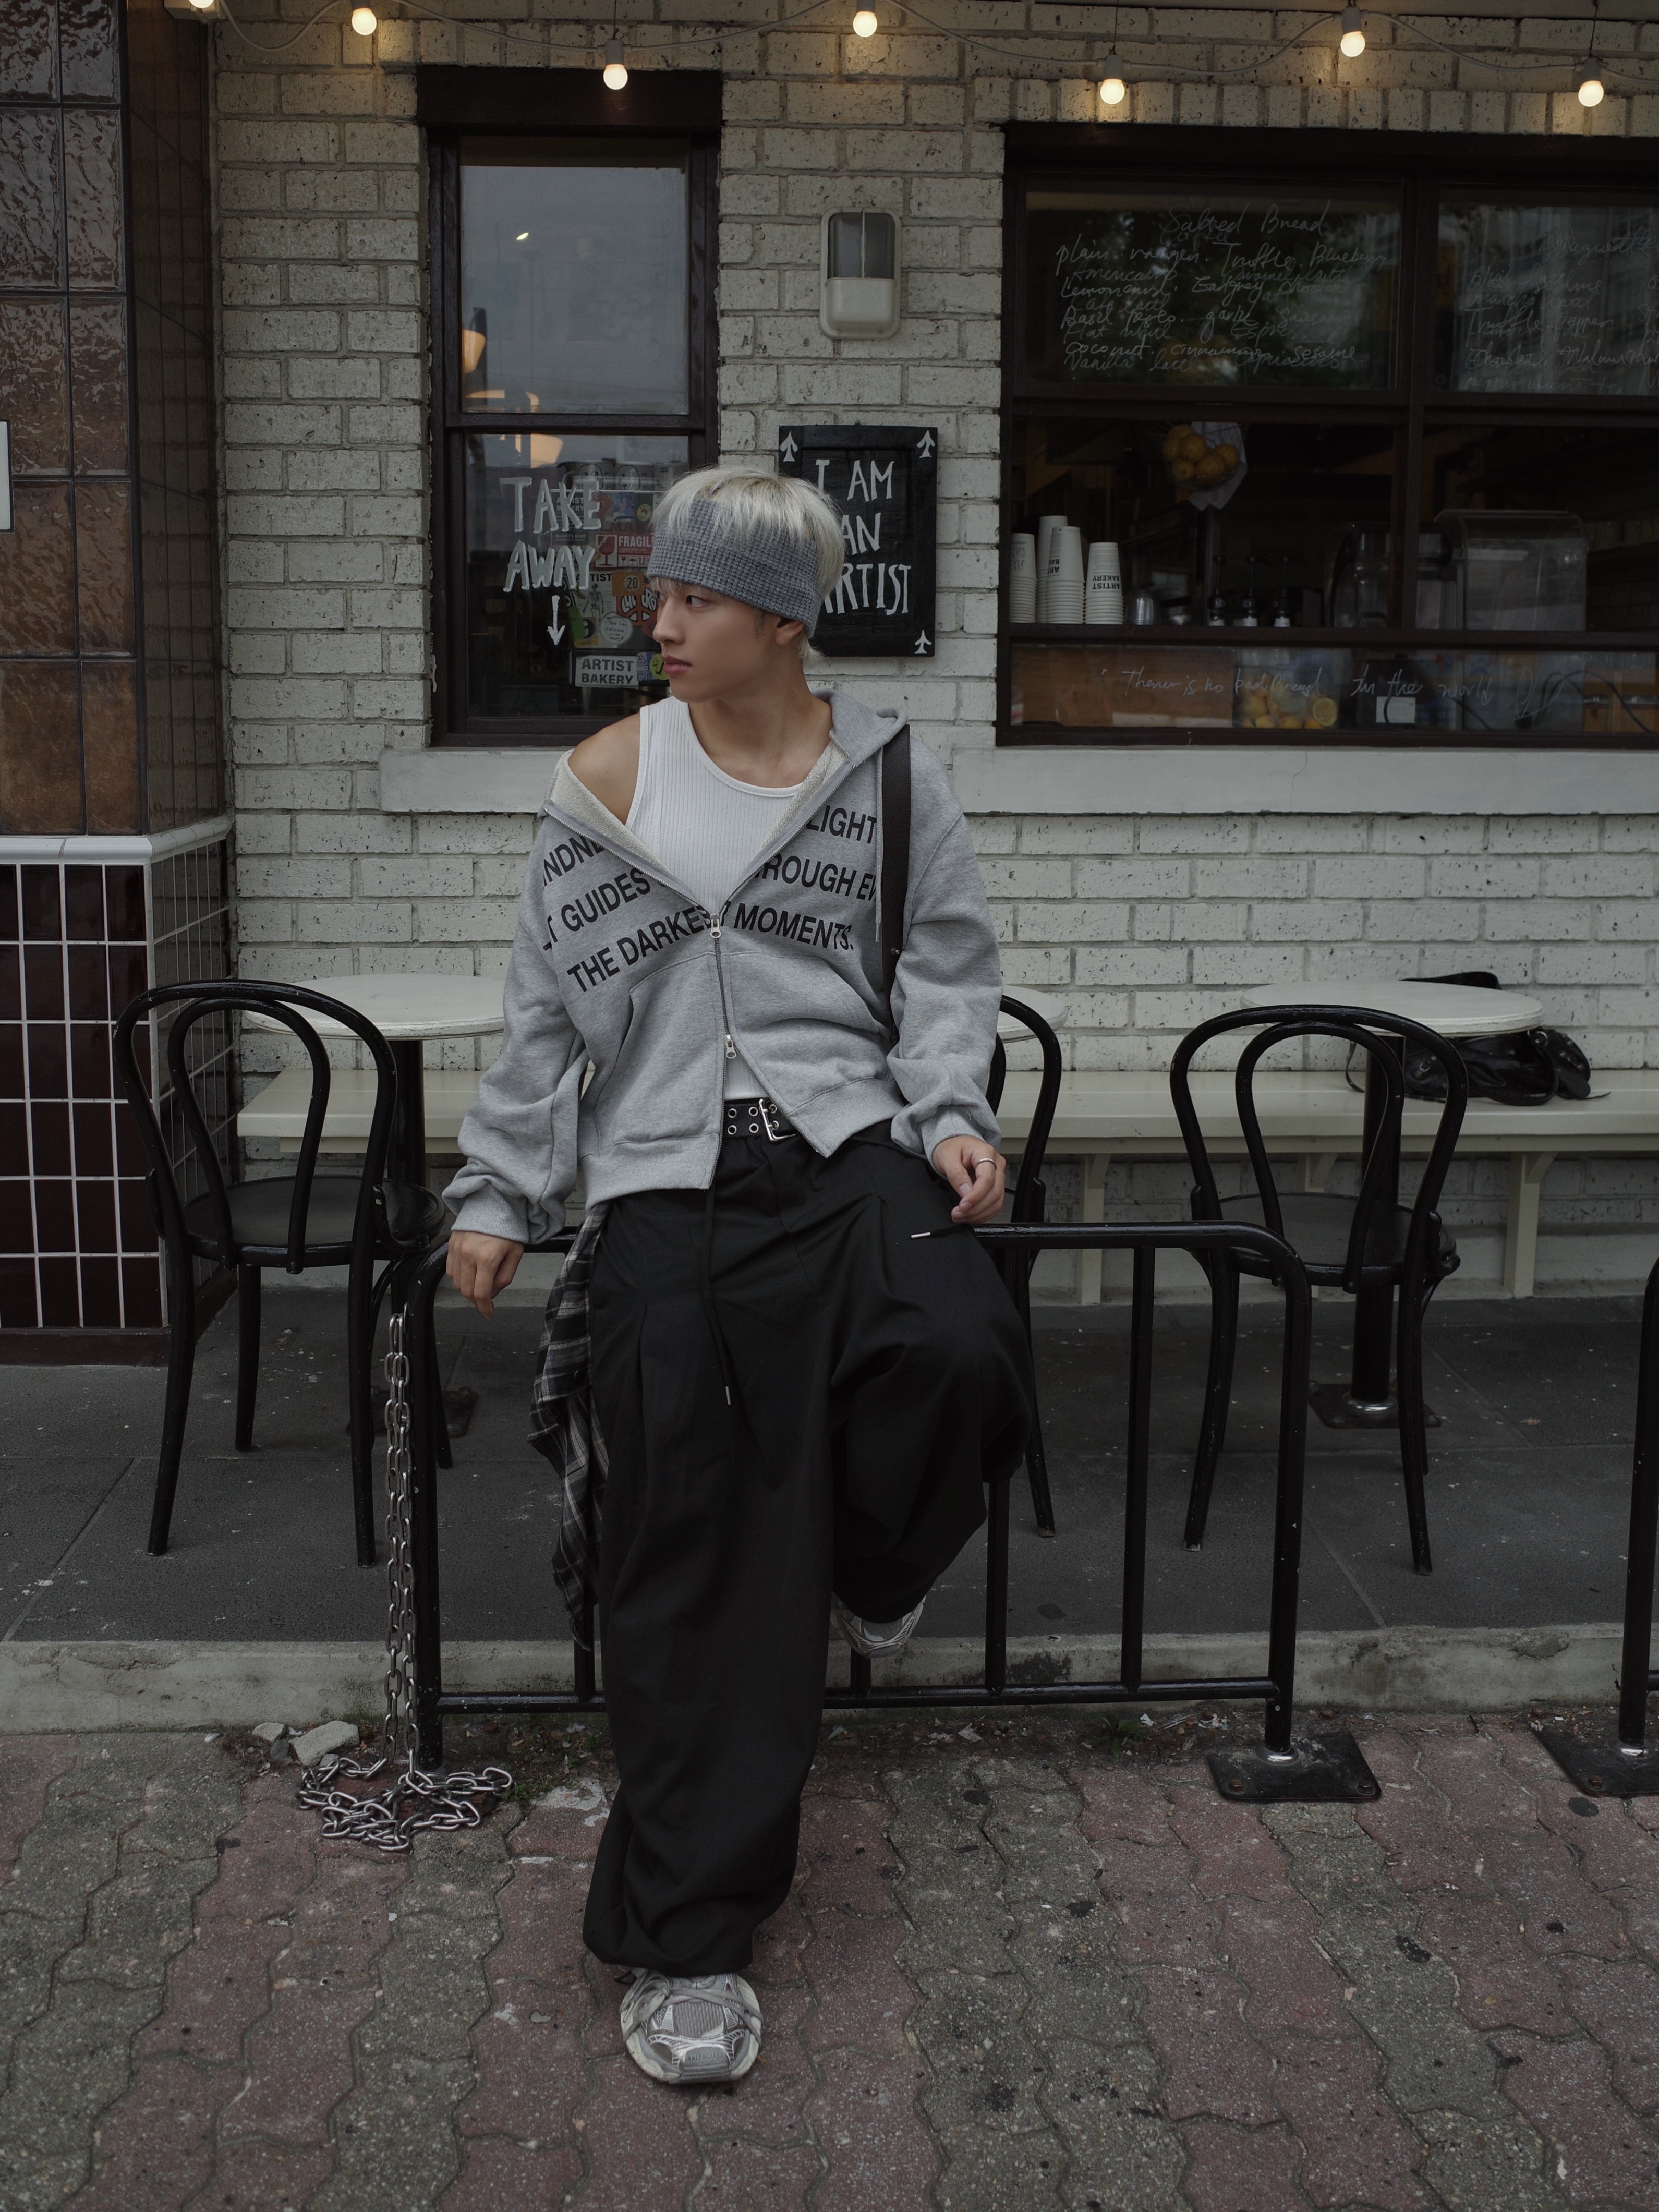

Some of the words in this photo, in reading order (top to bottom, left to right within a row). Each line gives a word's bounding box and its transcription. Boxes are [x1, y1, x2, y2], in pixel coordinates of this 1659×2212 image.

[1159, 203, 1250, 233] Salted
[847, 460, 895, 502] AM
[499, 476, 602, 534] TAKE
[502, 539, 596, 593] AWAY
[627, 577, 638, 589] 20
[582, 658, 634, 672] ARTIST
[582, 673, 634, 685] BAKERY
[1387, 668, 1423, 695] the
[561, 867, 651, 932] GUIDES
[754, 853, 857, 897] ROUGH
[567, 947, 620, 992] THE
[733, 902, 854, 950] MOMENTS.
